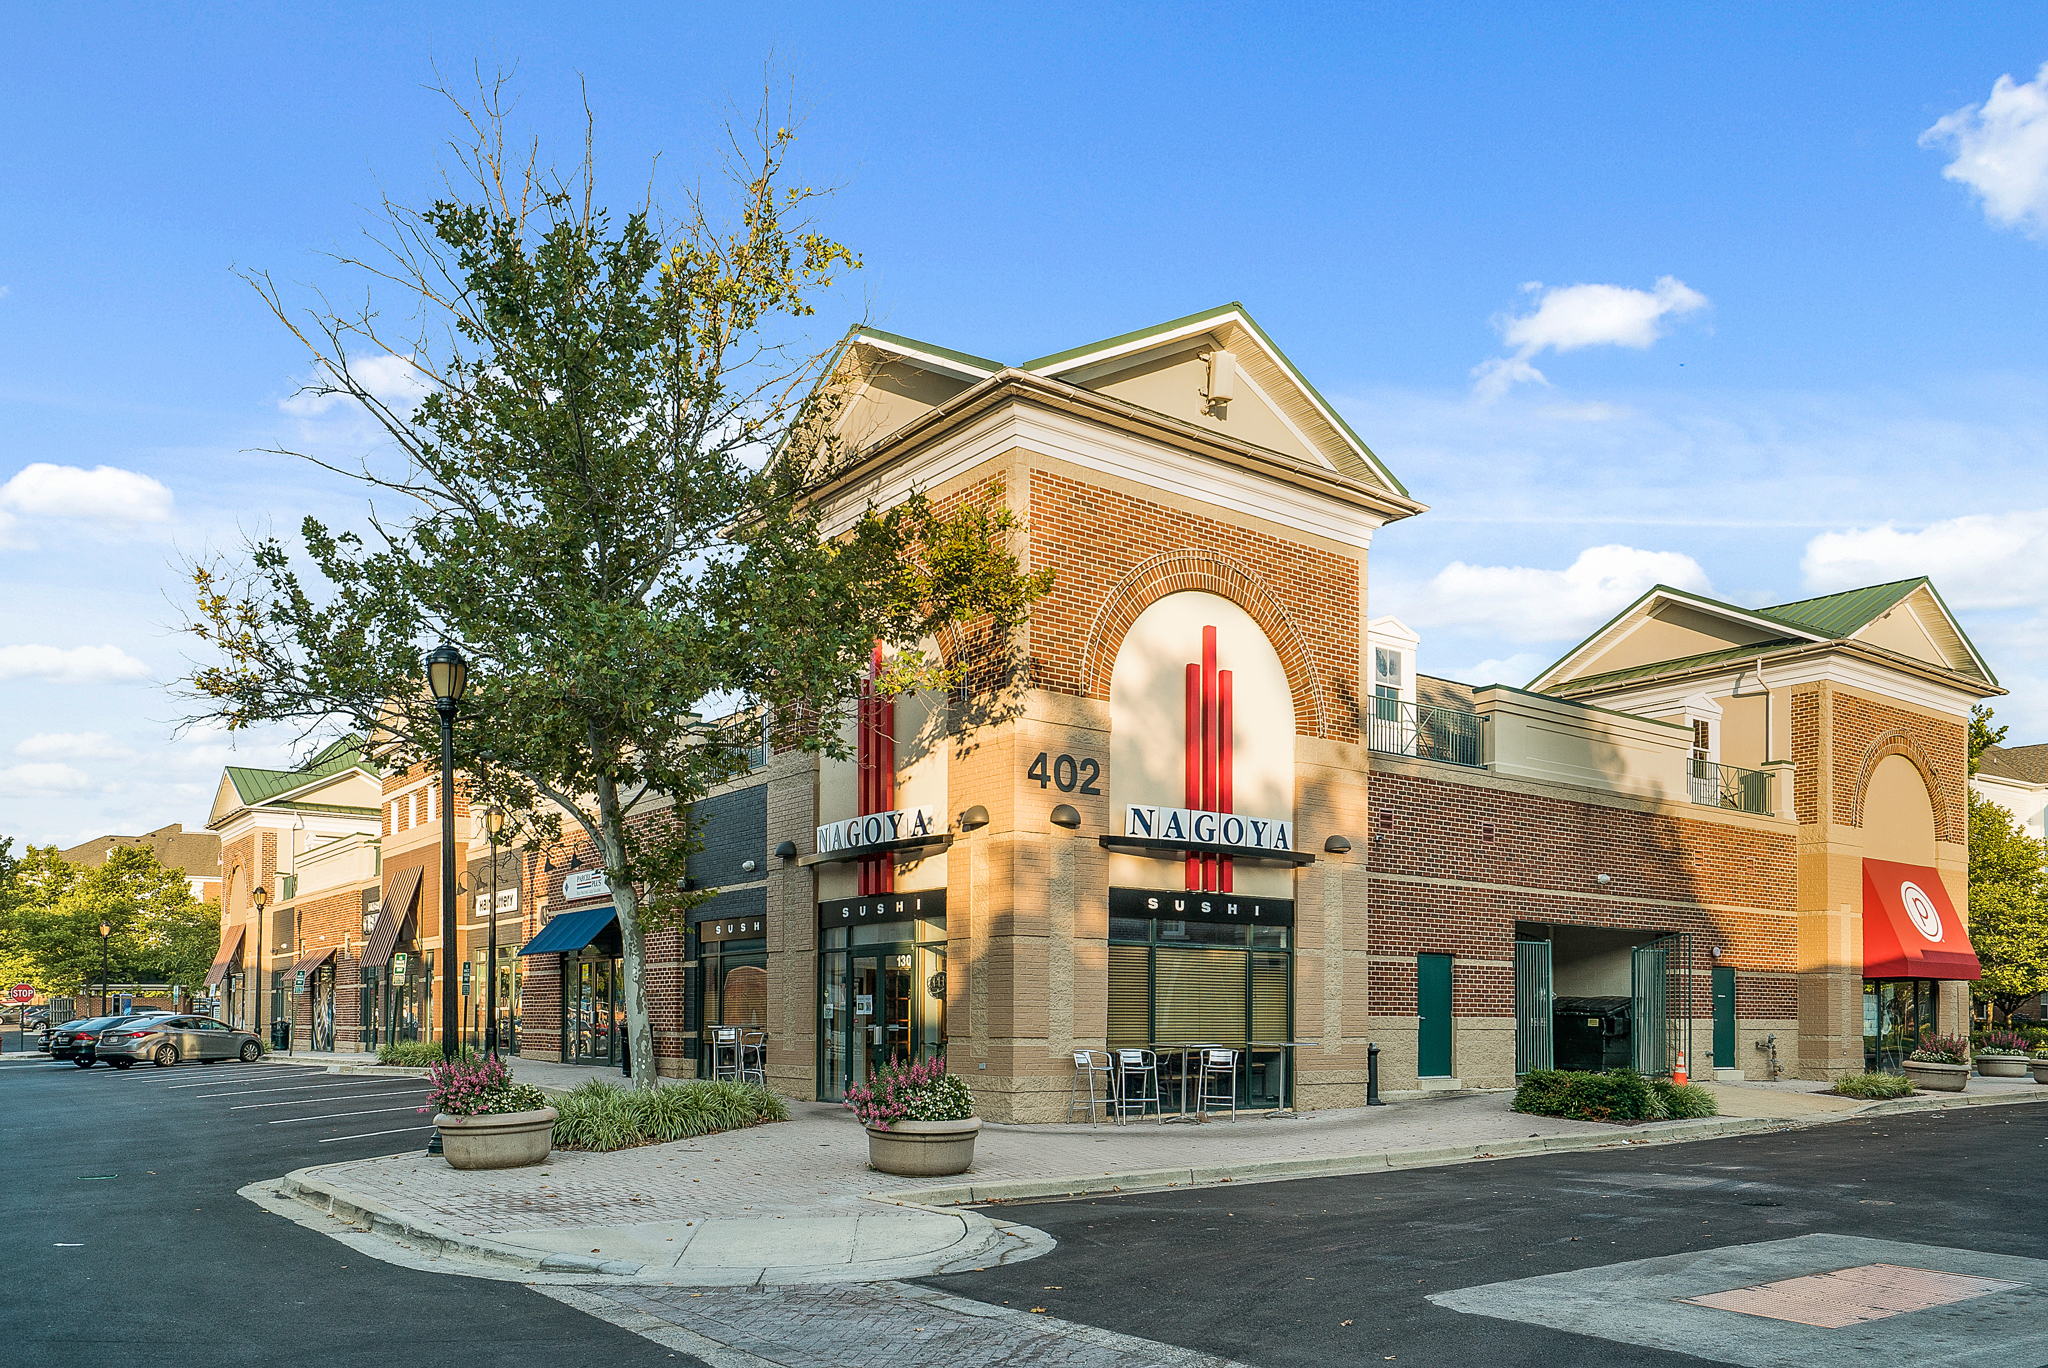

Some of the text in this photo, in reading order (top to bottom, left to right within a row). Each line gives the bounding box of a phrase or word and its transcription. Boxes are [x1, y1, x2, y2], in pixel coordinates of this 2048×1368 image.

[1027, 752, 1101, 795] 402
[818, 809, 930, 853] NAGOYA
[1129, 808, 1290, 850] NAGOYA
[842, 898, 921, 917] SUSHI
[1148, 898, 1259, 916] SUSHI
[715, 921, 760, 934] SUSH
[896, 955, 912, 967] 130
[13, 989, 33, 998] STOP
